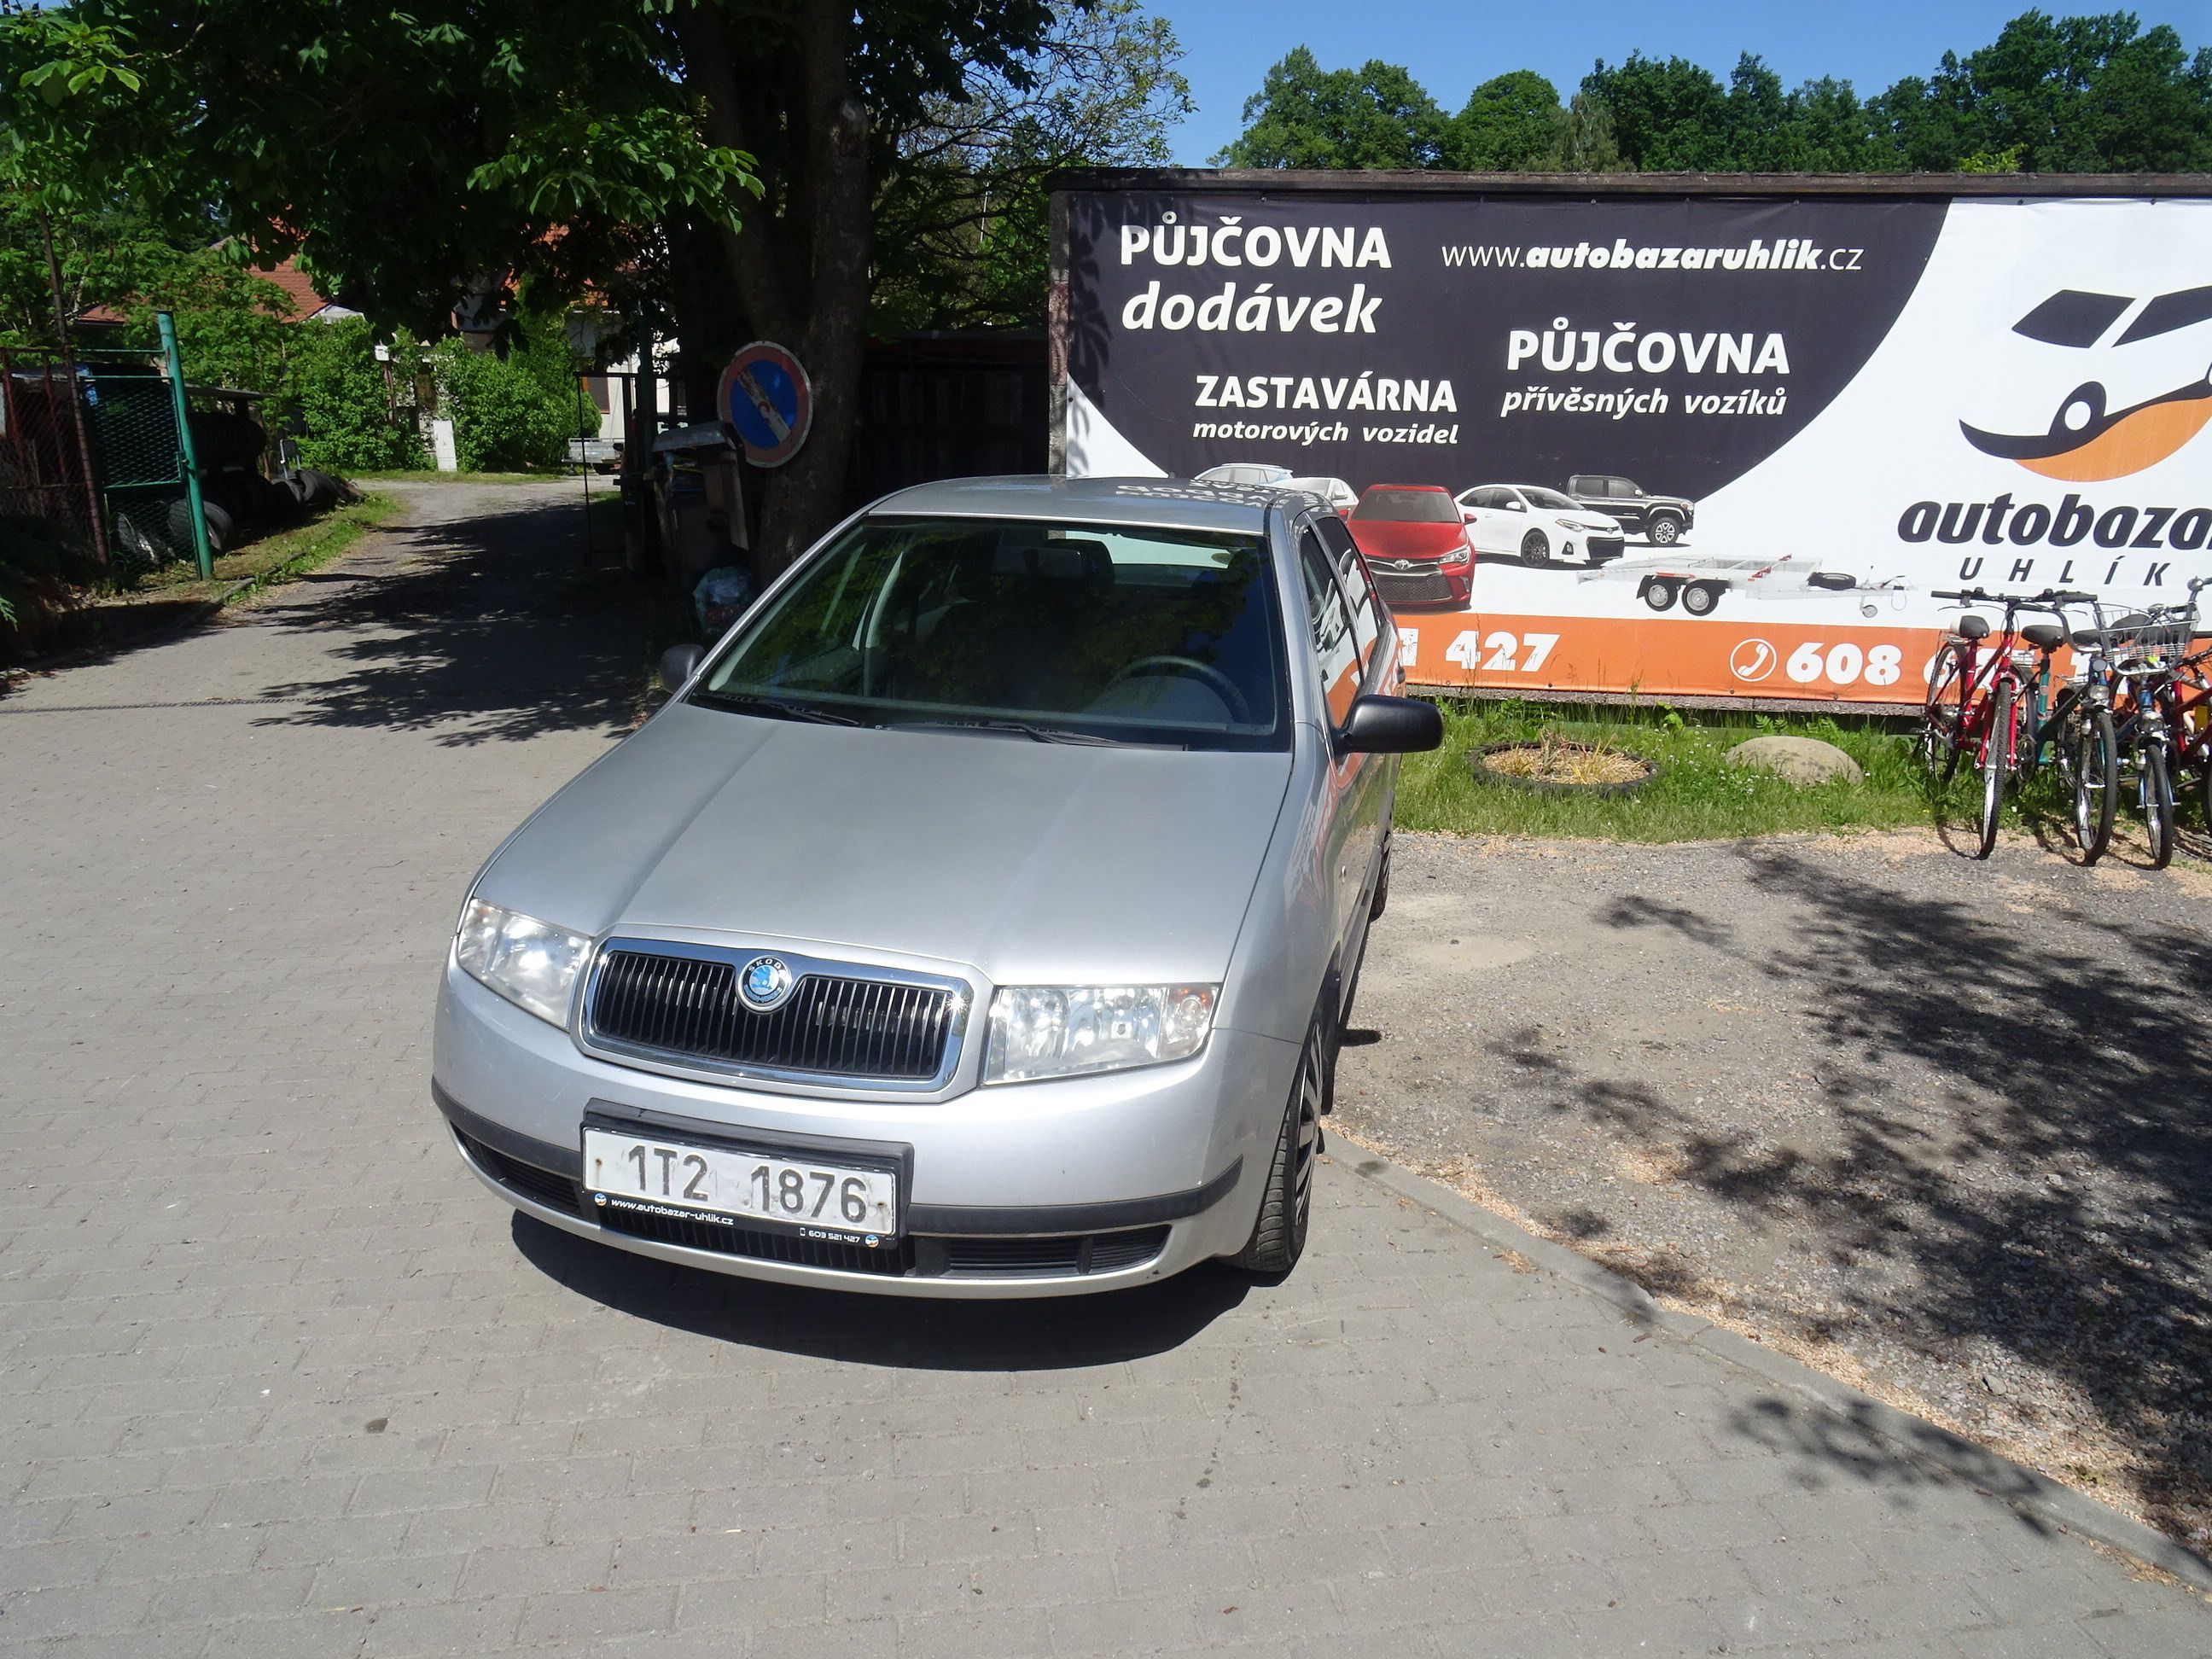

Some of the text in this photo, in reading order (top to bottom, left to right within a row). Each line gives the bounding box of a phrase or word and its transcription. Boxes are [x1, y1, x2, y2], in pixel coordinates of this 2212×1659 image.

[1121, 211, 1392, 269] PŮJČOVNA
[1441, 238, 1865, 271] www.autobazaruhlik.cz
[1121, 281, 1383, 334] dodávek
[1506, 317, 1790, 375] PŮJČOVNA
[1195, 370, 1458, 413] ZASTAVÁRNA
[1500, 385, 1787, 420] přívěsných vozíků
[1193, 420, 1458, 445] motorových vozidel
[1897, 492, 2212, 550] autobaza
[1445, 630, 1561, 672] 427
[1785, 642, 1902, 686] 608
[627, 1145, 867, 1223] 1T2 1876
[610, 1197, 734, 1226] www.autobazar-uhlik.cz
[808, 1229, 861, 1243] 603 521 427
